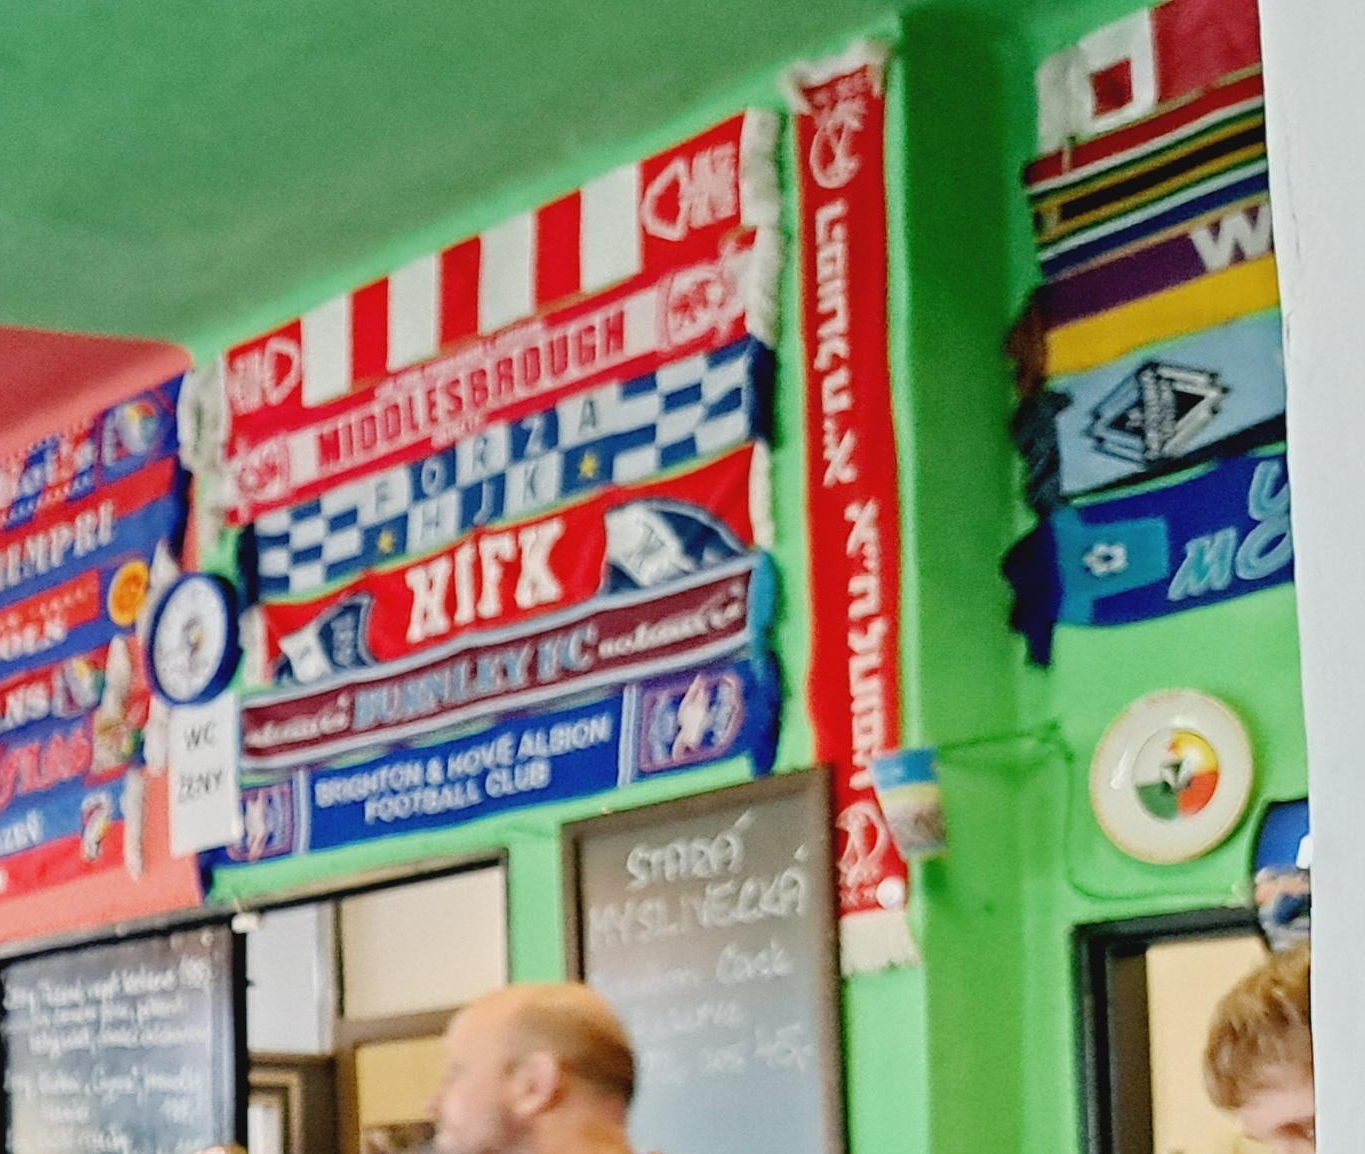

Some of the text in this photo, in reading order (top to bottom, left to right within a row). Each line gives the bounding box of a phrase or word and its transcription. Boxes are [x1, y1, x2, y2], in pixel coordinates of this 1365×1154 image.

[316, 309, 626, 469] MIDDLESBROUGH
[369, 397, 604, 512] FORZA
[416, 462, 561, 547] HJK
[405, 518, 566, 644] HIFK
[182, 724, 218, 751] WC
[315, 713, 614, 808] BRIGHTON & HOVE ALBION
[364, 760, 552, 826] FOOTBALL CLUB
[625, 808, 755, 891] STARÁ
